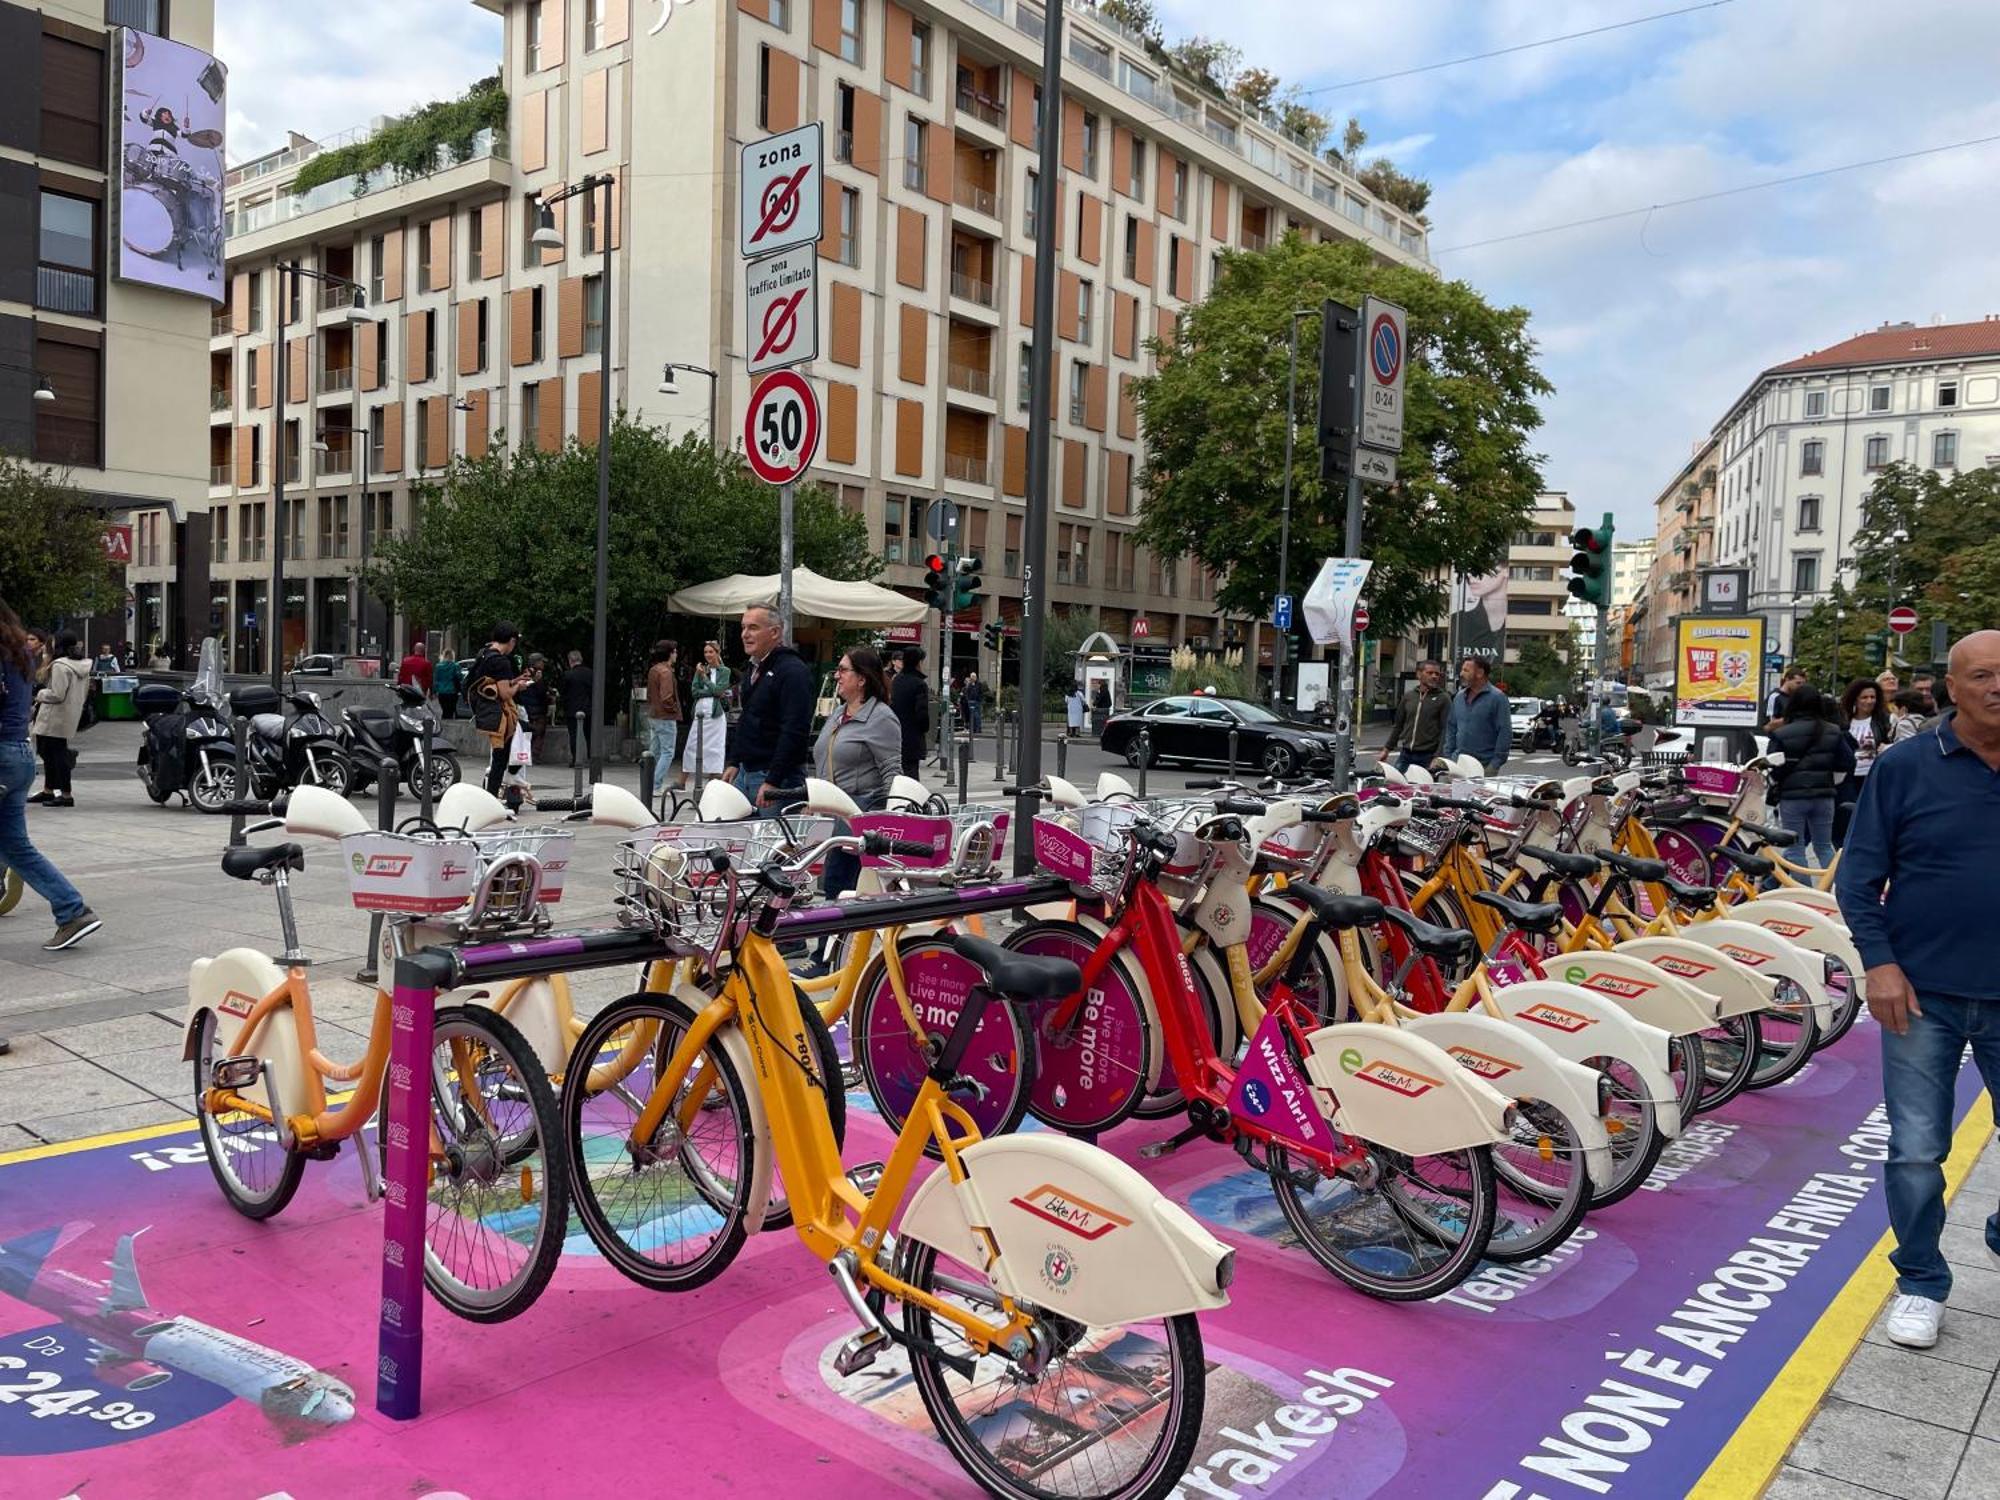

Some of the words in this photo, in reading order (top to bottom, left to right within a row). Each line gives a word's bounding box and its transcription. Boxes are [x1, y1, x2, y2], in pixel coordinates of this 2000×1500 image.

[759, 143, 801, 168] zona
[771, 260, 788, 273] zona
[750, 275, 778, 297] traffico
[779, 269, 811, 287] limitato
[1376, 391, 1393, 409] 0-24
[760, 400, 802, 454] 50
[1717, 583, 1730, 594] 16
[1278, 596, 1290, 612] P
[1134, 621, 1148, 634] M
[1463, 647, 1499, 657] RADA
[1691, 650, 1715, 661] WAKE
[910, 982, 936, 1000] Live
[939, 991, 966, 1006] mor
[918, 972, 937, 985] See
[940, 979, 966, 991] more
[1087, 988, 1104, 1021] Be
[1101, 1005, 1116, 1038] Live
[1080, 1025, 1097, 1090] more
[1098, 1042, 1110, 1084] more
[1281, 1049, 1293, 1074] Vola
[1292, 1076, 1305, 1096] con
[1282, 1089, 1308, 1123] Air!
[1766, 1172, 1877, 1239] FINITA
[1656, 1237, 1822, 1360] ANCORA
[23, 1336, 64, 1357] Da
[1605, 1348, 1713, 1389] È
[1519, 1379, 1685, 1494] NON
